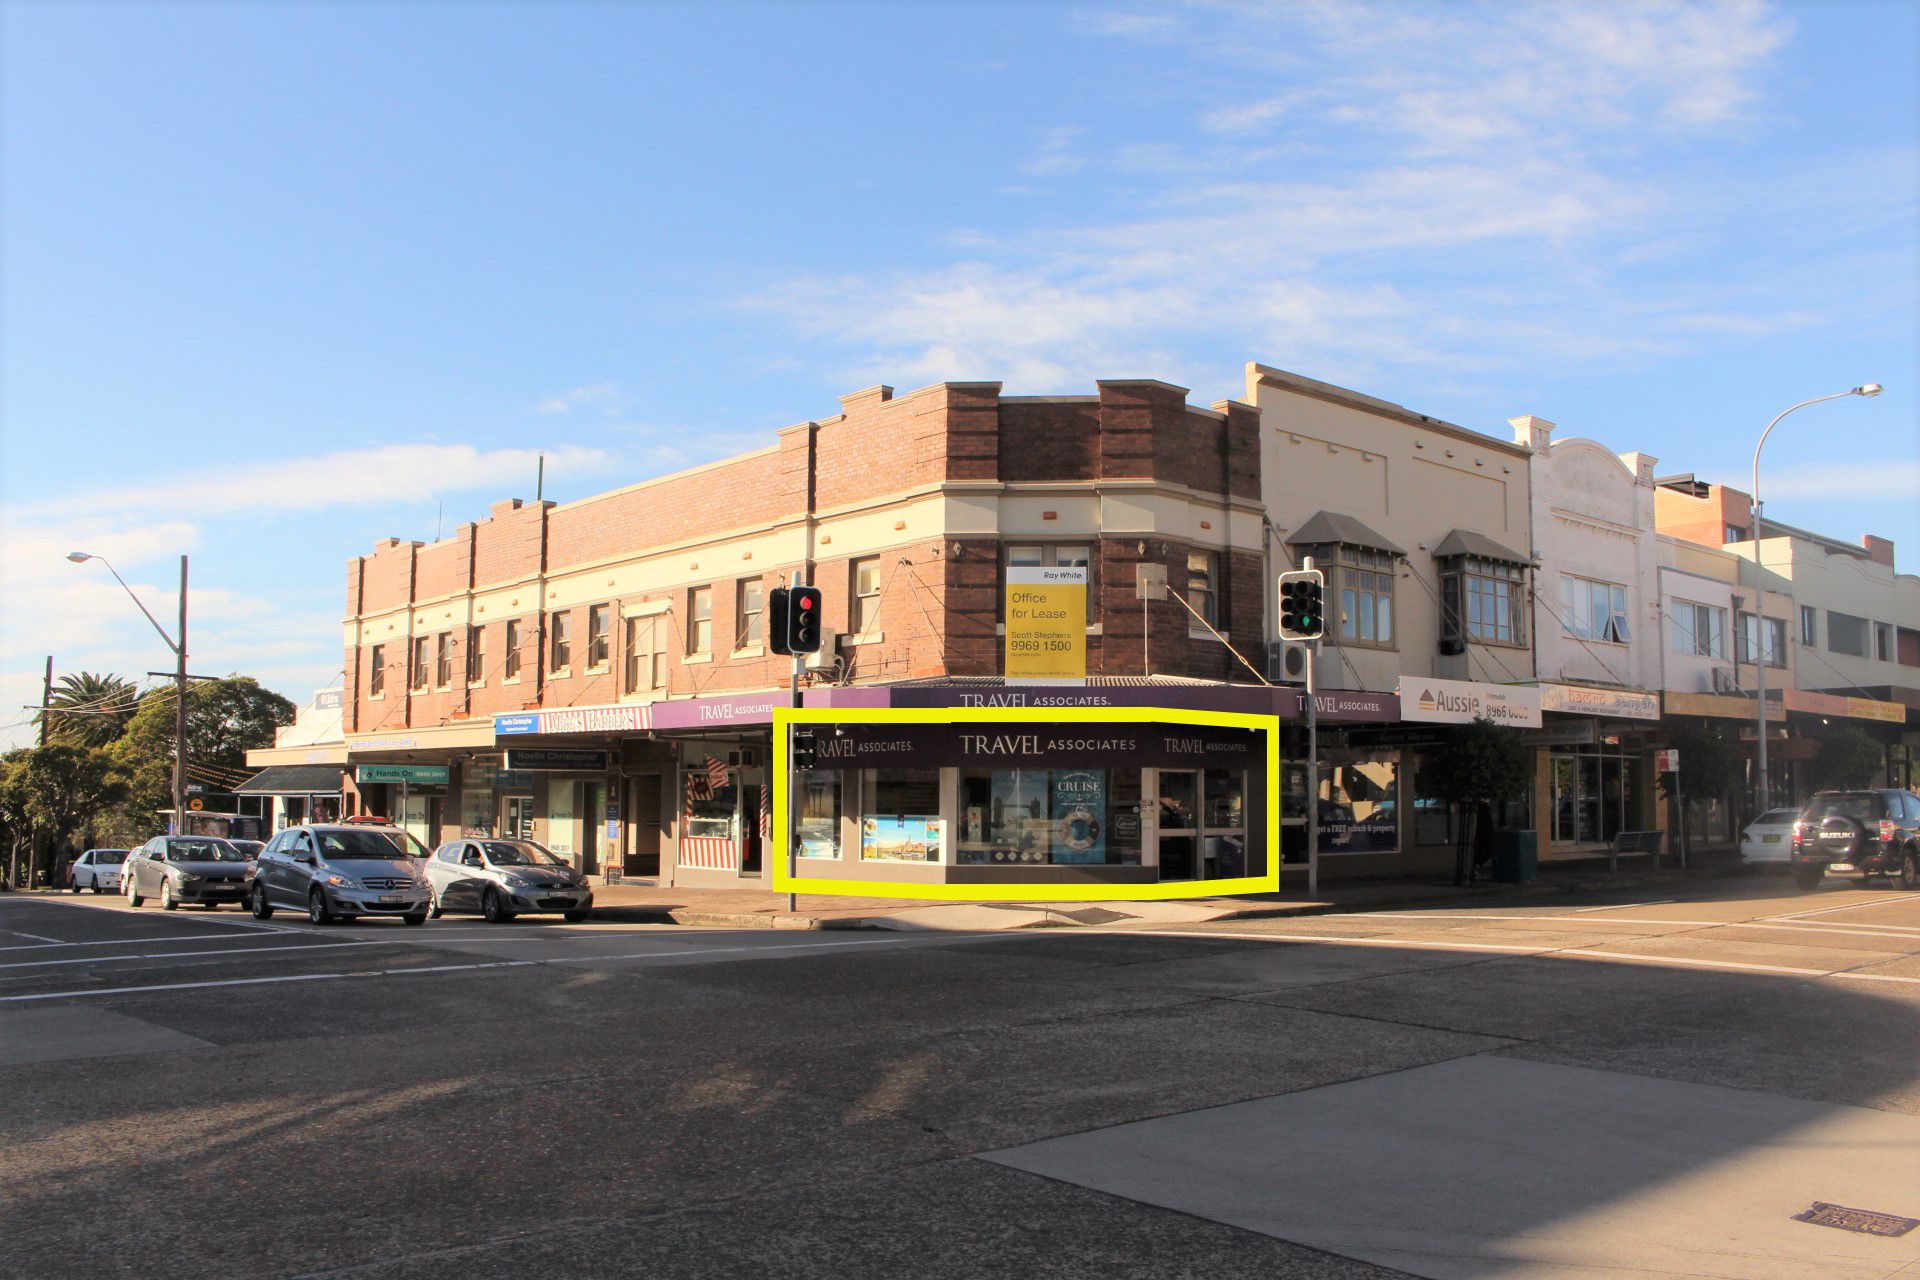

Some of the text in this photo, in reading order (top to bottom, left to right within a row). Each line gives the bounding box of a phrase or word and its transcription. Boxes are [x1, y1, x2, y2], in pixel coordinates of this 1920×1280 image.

[1043, 572, 1059, 580] Ray
[1012, 592, 1047, 603] Office
[1012, 608, 1067, 619] for Lease
[1011, 631, 1072, 640] Scott Stephens
[1011, 641, 1072, 651] 9969 1500
[959, 693, 1107, 707] TRAVEL ASSOCIATES
[1296, 695, 1380, 712] TAVEL ASSOCIATES
[1436, 690, 1480, 713] Aussie
[699, 704, 774, 720] TRAVEL ASSOCIATES
[817, 739, 912, 757] RAVEL ASSOCIATES
[959, 735, 1136, 754] TRAVEL ASSOCIATES
[1164, 738, 1246, 753] TRAVEL ASSOCIATES
[1058, 781, 1100, 792] CRUISE
[1373, 825, 1396, 834] property
